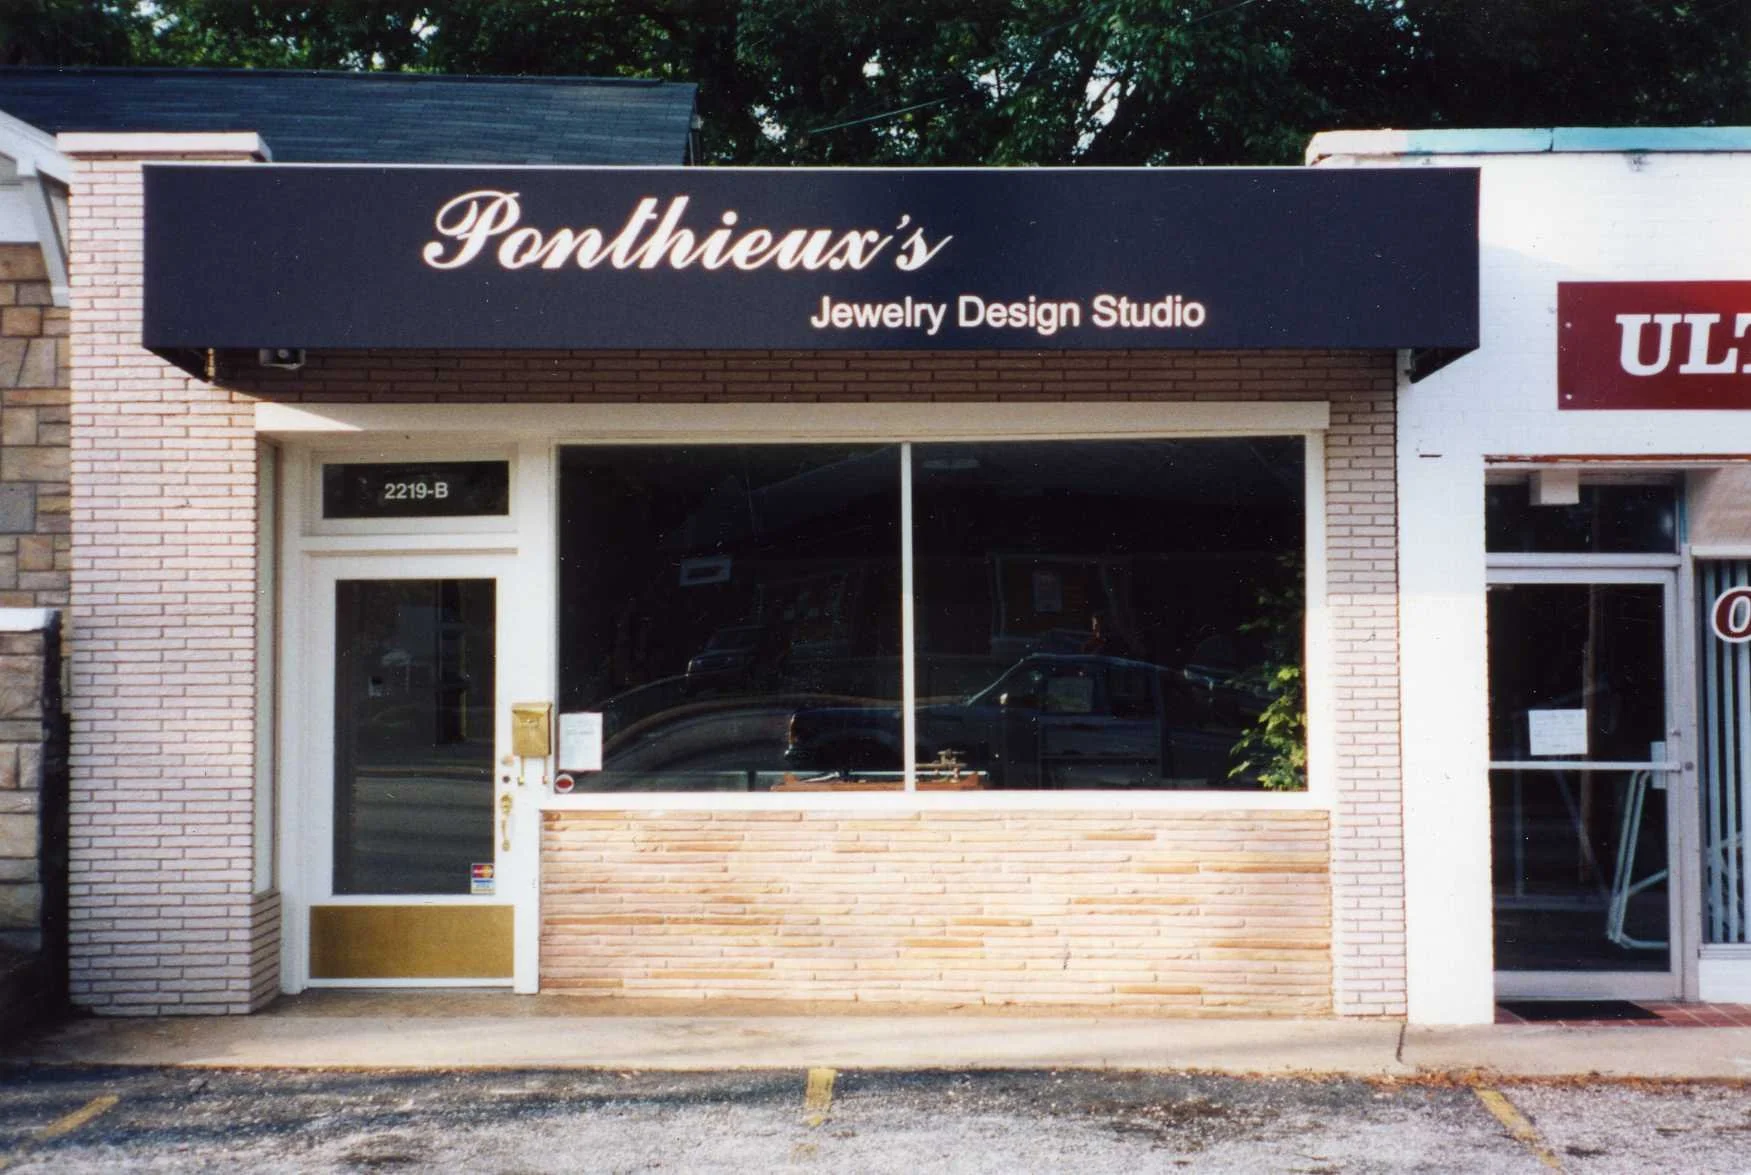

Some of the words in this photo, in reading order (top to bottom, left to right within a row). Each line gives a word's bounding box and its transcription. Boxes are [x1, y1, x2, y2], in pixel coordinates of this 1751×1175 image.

[422, 189, 953, 272] Ponthieux's
[810, 295, 946, 336] Jewelry
[957, 295, 1081, 336] Design
[1091, 293, 1206, 329] Studio
[384, 482, 449, 500] 2219-B
